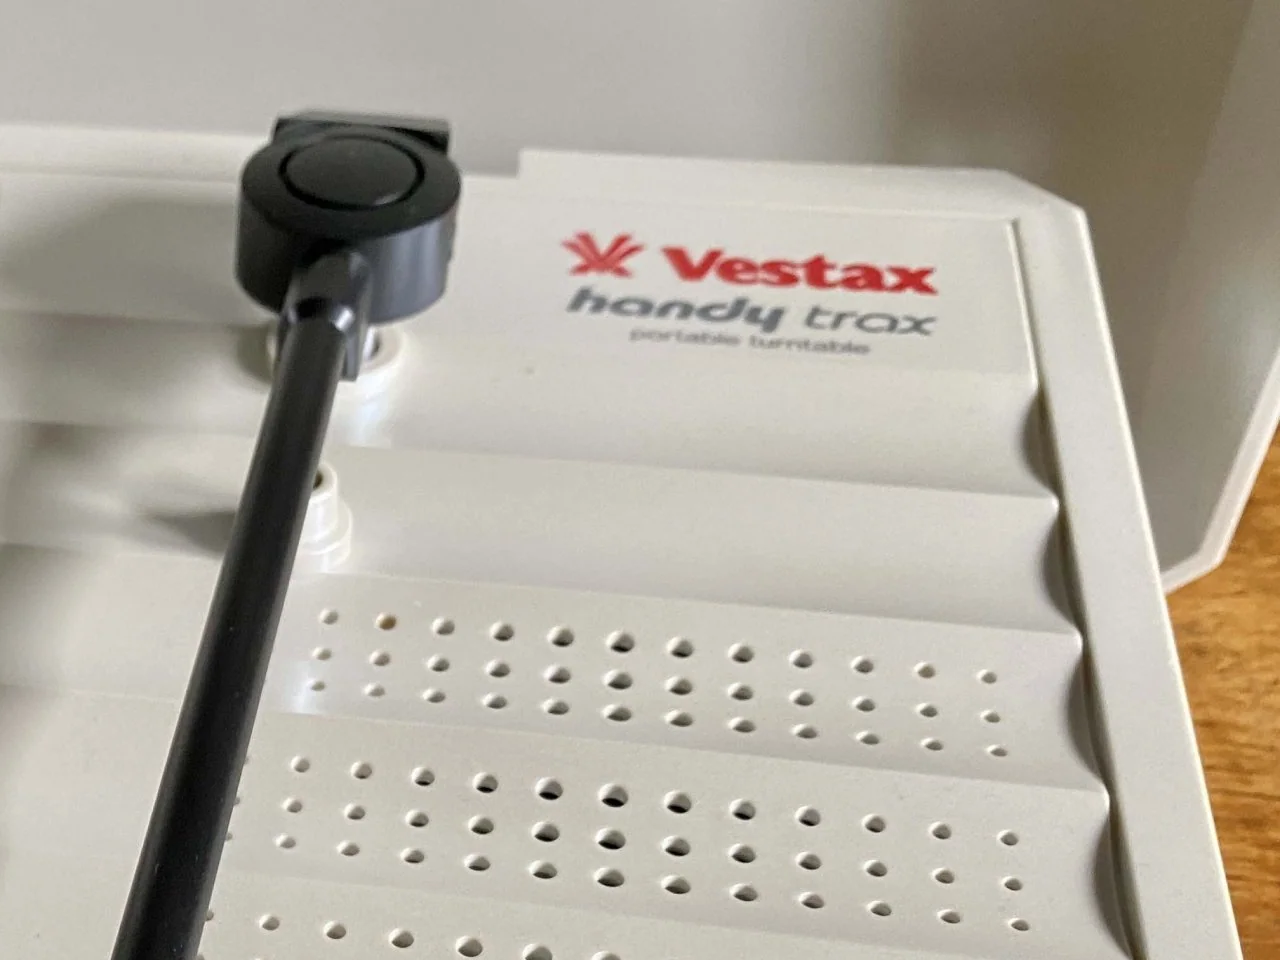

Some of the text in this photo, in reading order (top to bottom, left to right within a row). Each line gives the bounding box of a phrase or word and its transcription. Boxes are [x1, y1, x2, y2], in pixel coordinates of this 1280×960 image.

[662, 246, 938, 295] Vestax
[566, 286, 937, 337] handy trax
[629, 328, 871, 356] portable turntable
